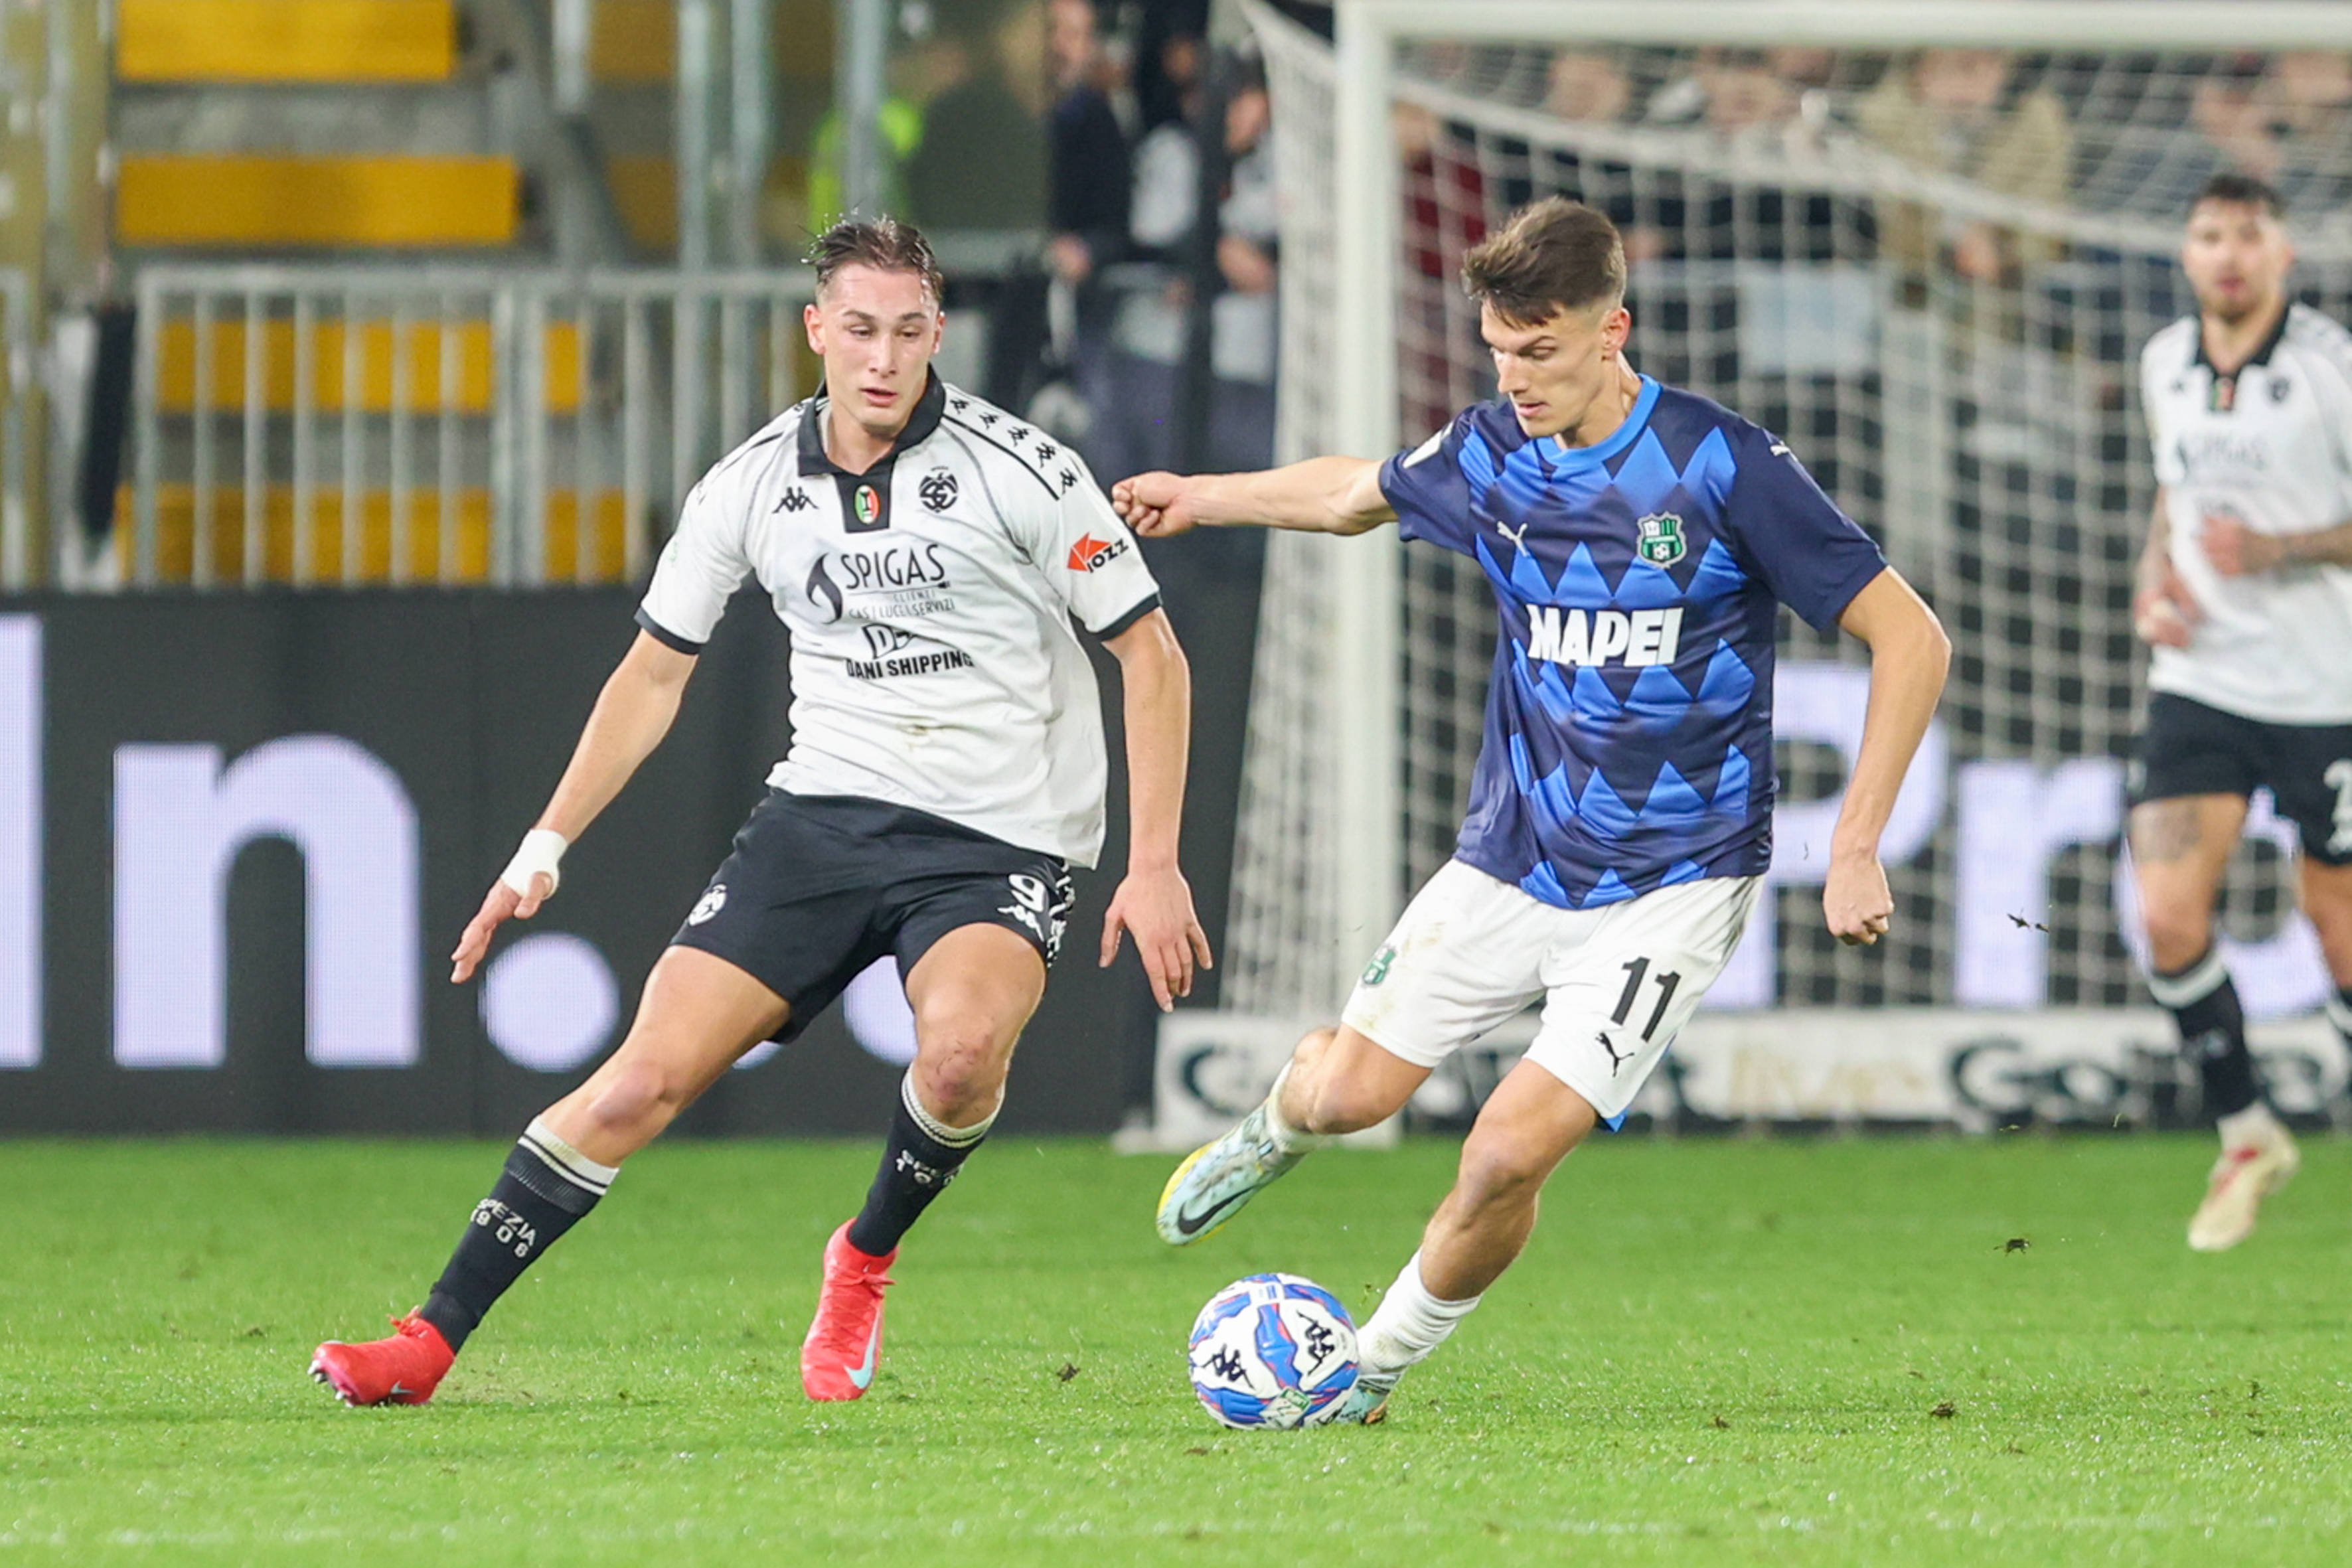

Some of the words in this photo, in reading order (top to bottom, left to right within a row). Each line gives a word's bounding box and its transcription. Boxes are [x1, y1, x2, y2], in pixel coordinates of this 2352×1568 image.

[841, 544, 945, 589] SPIGAS
[1525, 603, 1684, 667] MAPEI
[846, 657, 883, 679] DANI
[886, 651, 975, 676] SHIPPING
[1008, 867, 1048, 913] 9
[1610, 956, 1682, 1043] 11
[477, 1198, 536, 1247] SPEZIA
